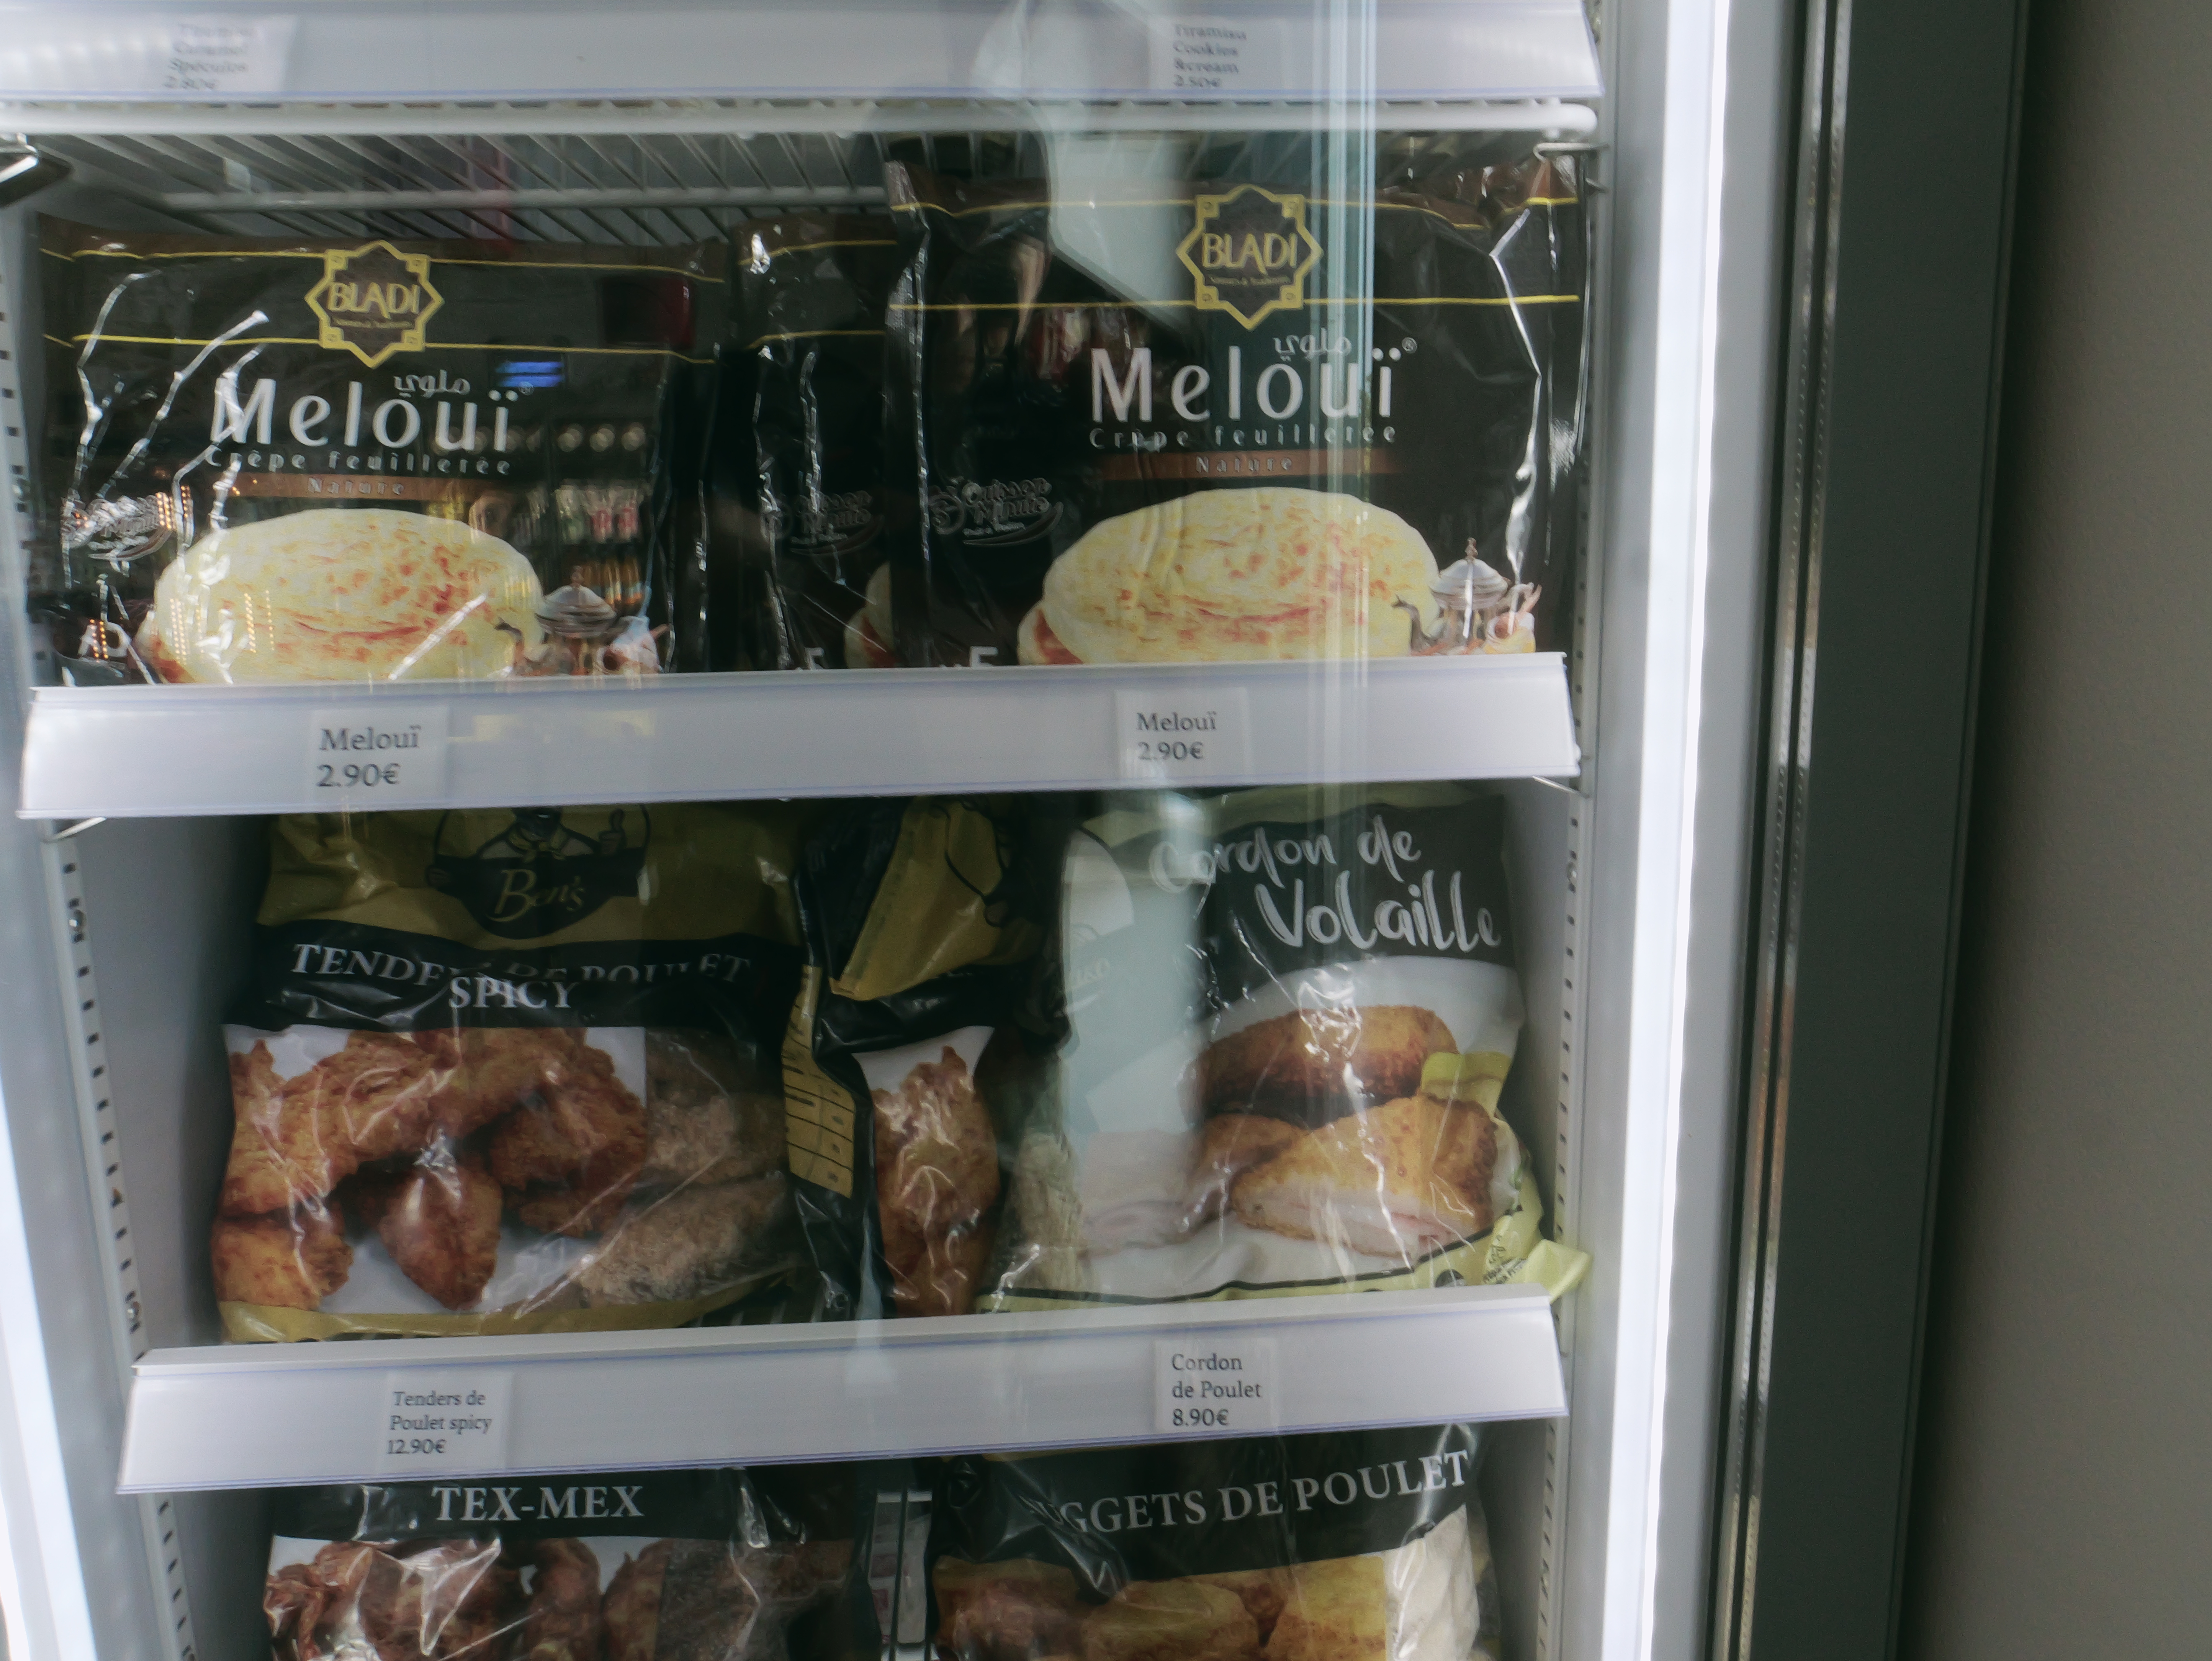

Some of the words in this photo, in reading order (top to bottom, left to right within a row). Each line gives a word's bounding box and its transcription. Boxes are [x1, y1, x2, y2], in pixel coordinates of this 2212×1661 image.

[1203, 233, 1297, 275] BLADI
[327, 282, 420, 319] BLADI
[393, 369, 471, 398] ملوي
[1196, 455, 1293, 473] Nature
[308, 478, 404, 495] Nature
[1137, 711, 1217, 731] Melouï
[318, 724, 421, 751] Melouï
[1137, 742, 1204, 760] 2.90€
[316, 763, 401, 787] 2.90€
[1150, 827, 1337, 893] Cordon
[1358, 815, 1422, 883] de
[1255, 870, 1501, 952] Volaille
[290, 943, 491, 986] TENDE
[449, 975, 579, 1009] SPICY
[1172, 1353, 1243, 1370] Cordon
[393, 1390, 461, 1406] Tenders
[466, 1390, 486, 1405] de
[1173, 1381, 1194, 1398] de
[1200, 1380, 1261, 1398] Poulet
[389, 1414, 445, 1430] Poulet
[450, 1414, 492, 1435] spicy
[1172, 1408, 1229, 1426] 8.90€
[387, 1439, 447, 1455] 12.90€
[1219, 1481, 1283, 1522] DE
[1292, 1450, 1469, 1512] POULET
[432, 1486, 645, 1521] TEX-MEX
